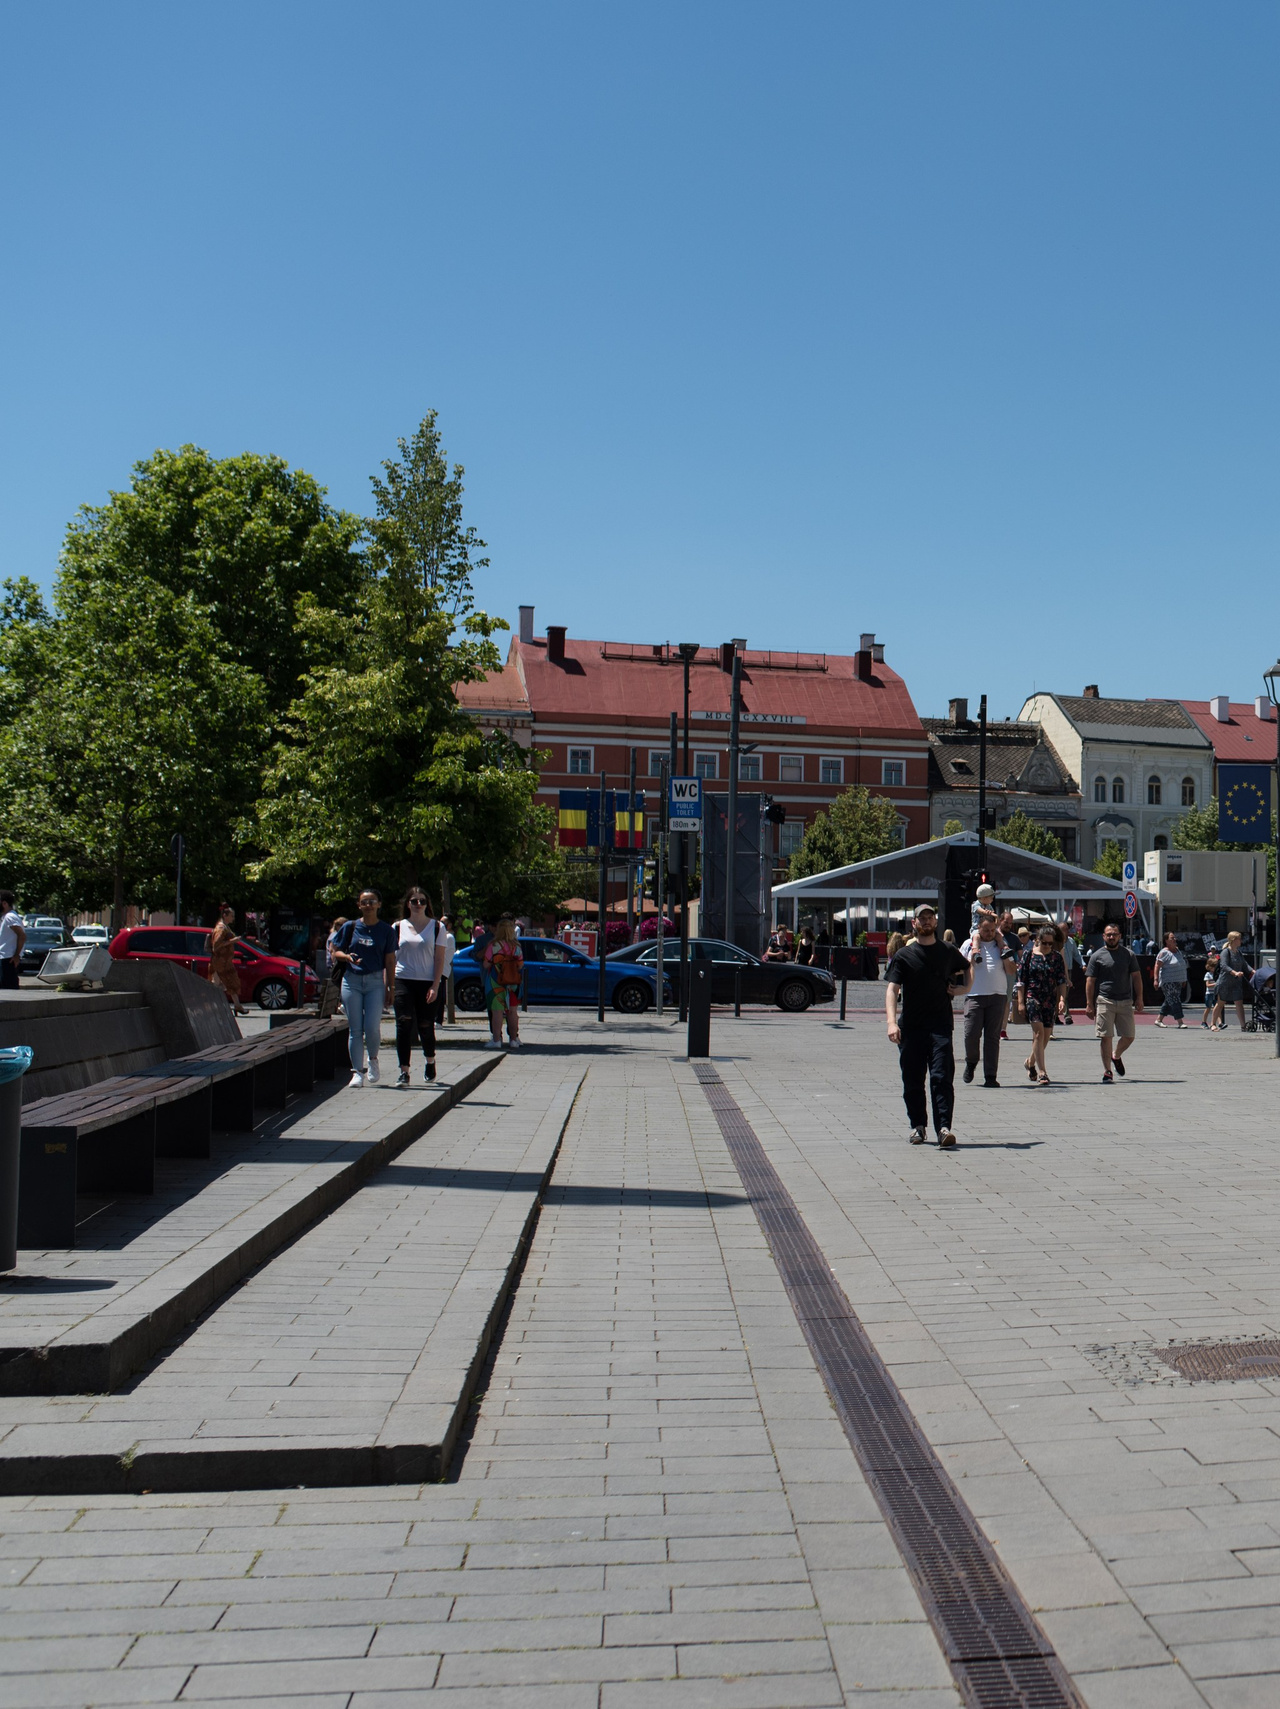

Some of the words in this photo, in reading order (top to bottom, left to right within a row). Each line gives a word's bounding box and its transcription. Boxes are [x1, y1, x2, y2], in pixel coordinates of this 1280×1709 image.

[705, 711, 794, 723] MDCCXXVIII
[674, 783, 698, 798] WC
[672, 820, 689, 828] 180m
